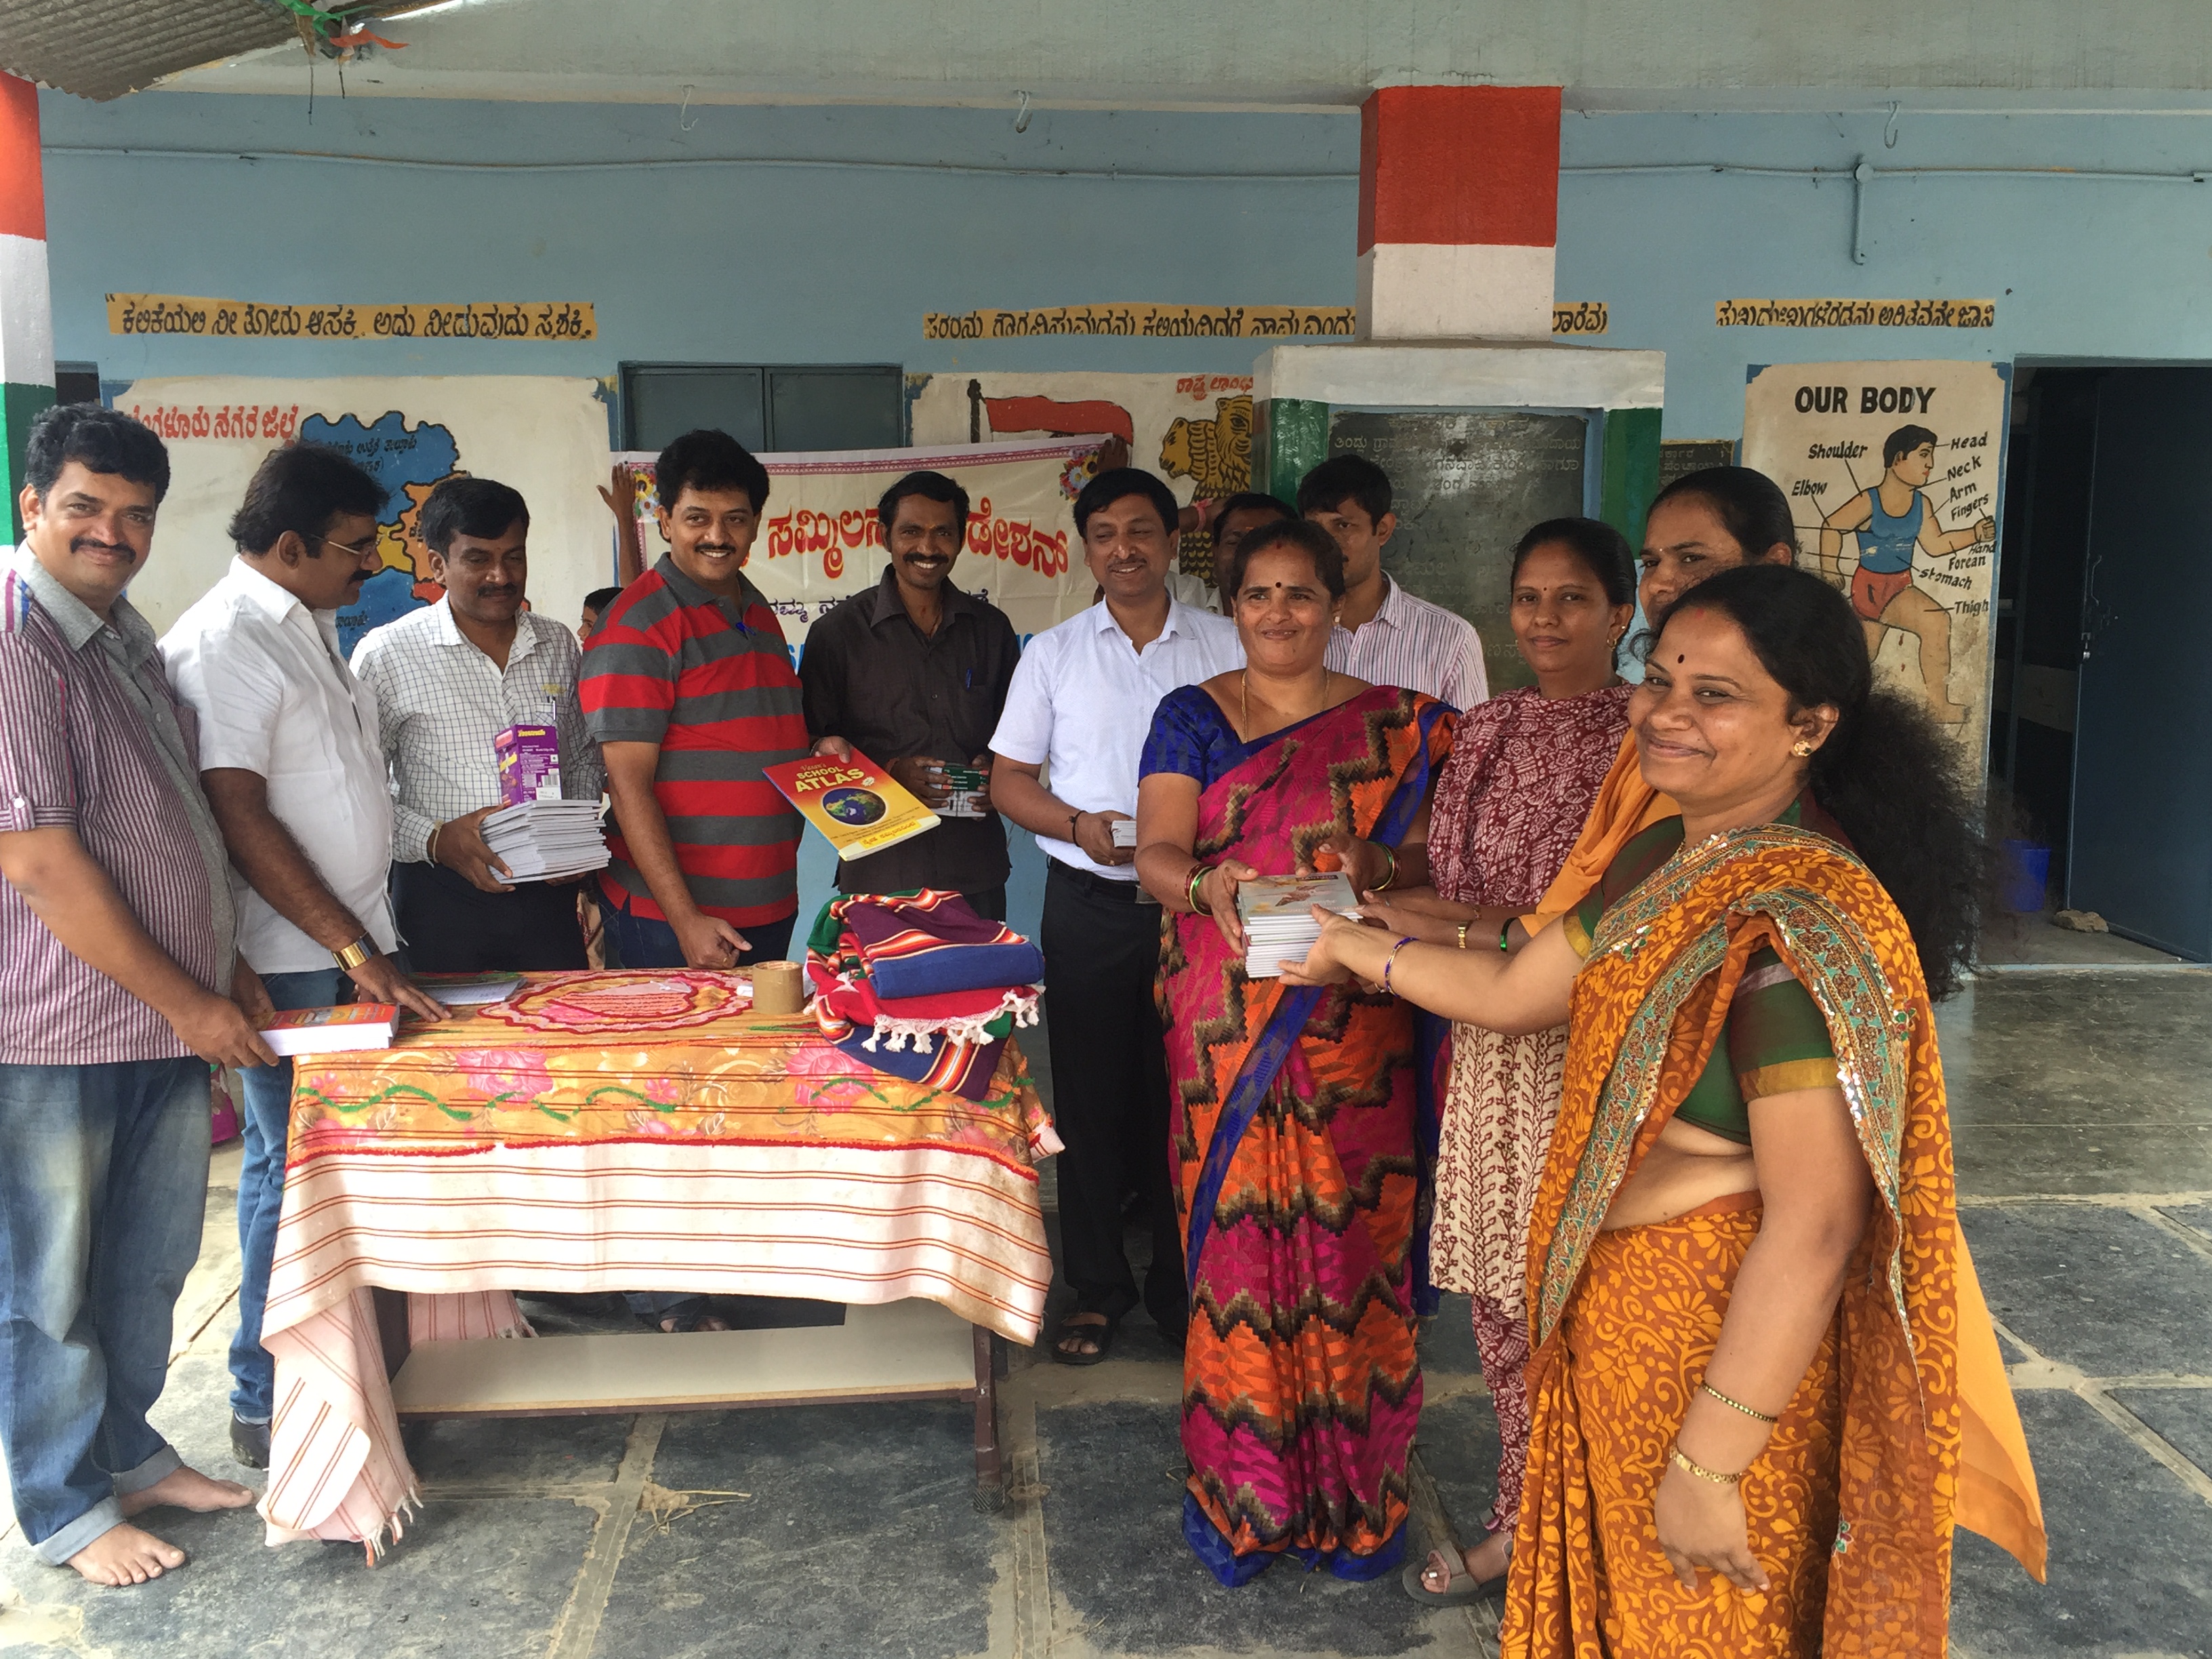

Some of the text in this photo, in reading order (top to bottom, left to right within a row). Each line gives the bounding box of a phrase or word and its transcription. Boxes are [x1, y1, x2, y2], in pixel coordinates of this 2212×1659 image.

[374, 306, 415, 336] ಅದು
[1795, 386, 1937, 415] OUR BODY
[213, 405, 259, 439] ನಗರ
[1807, 441, 1868, 459] Shoulder
[1950, 432, 1988, 450] Head
[1947, 455, 1982, 481] Neck
[1791, 480, 1828, 497] Elbow
[1949, 480, 1978, 503] Arm
[1950, 493, 1990, 521] Fingers
[1969, 541, 1996, 555] Hand
[1948, 555, 1987, 571] Forean
[1954, 599, 1989, 617] Thigh
[795, 768, 865, 793] ATLAS
[796, 766, 844, 779] SCHOOL
